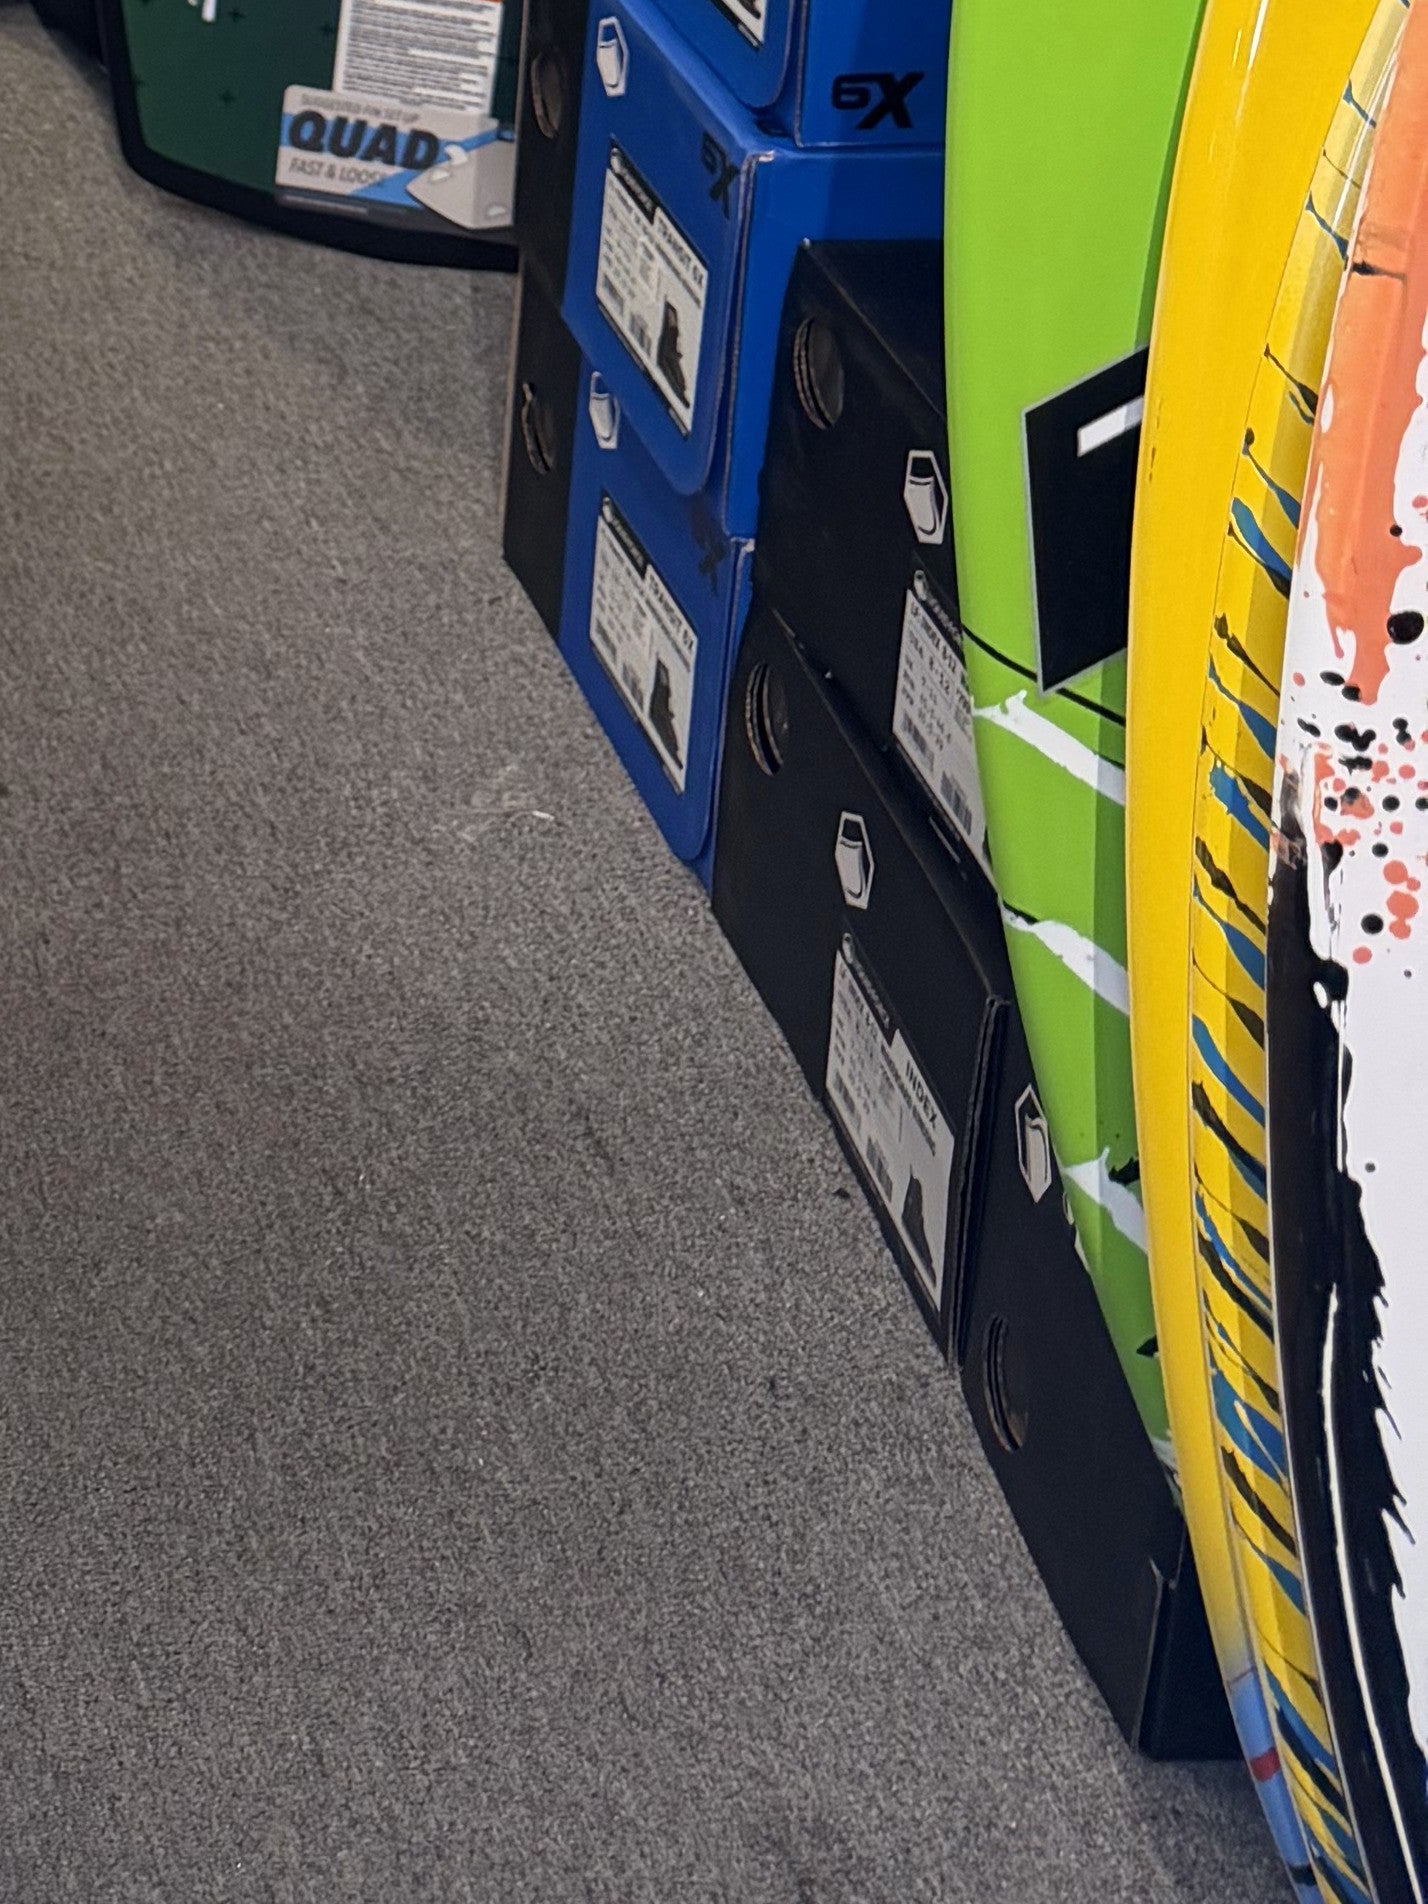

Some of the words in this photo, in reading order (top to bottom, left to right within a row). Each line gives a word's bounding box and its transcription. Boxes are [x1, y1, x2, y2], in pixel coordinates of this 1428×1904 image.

[832, 71, 925, 130] 6X
[288, 110, 441, 171] QUAD
[288, 157, 325, 176] FAST
[327, 163, 337, 179] &
[905, 1058, 937, 1130] INDEX
